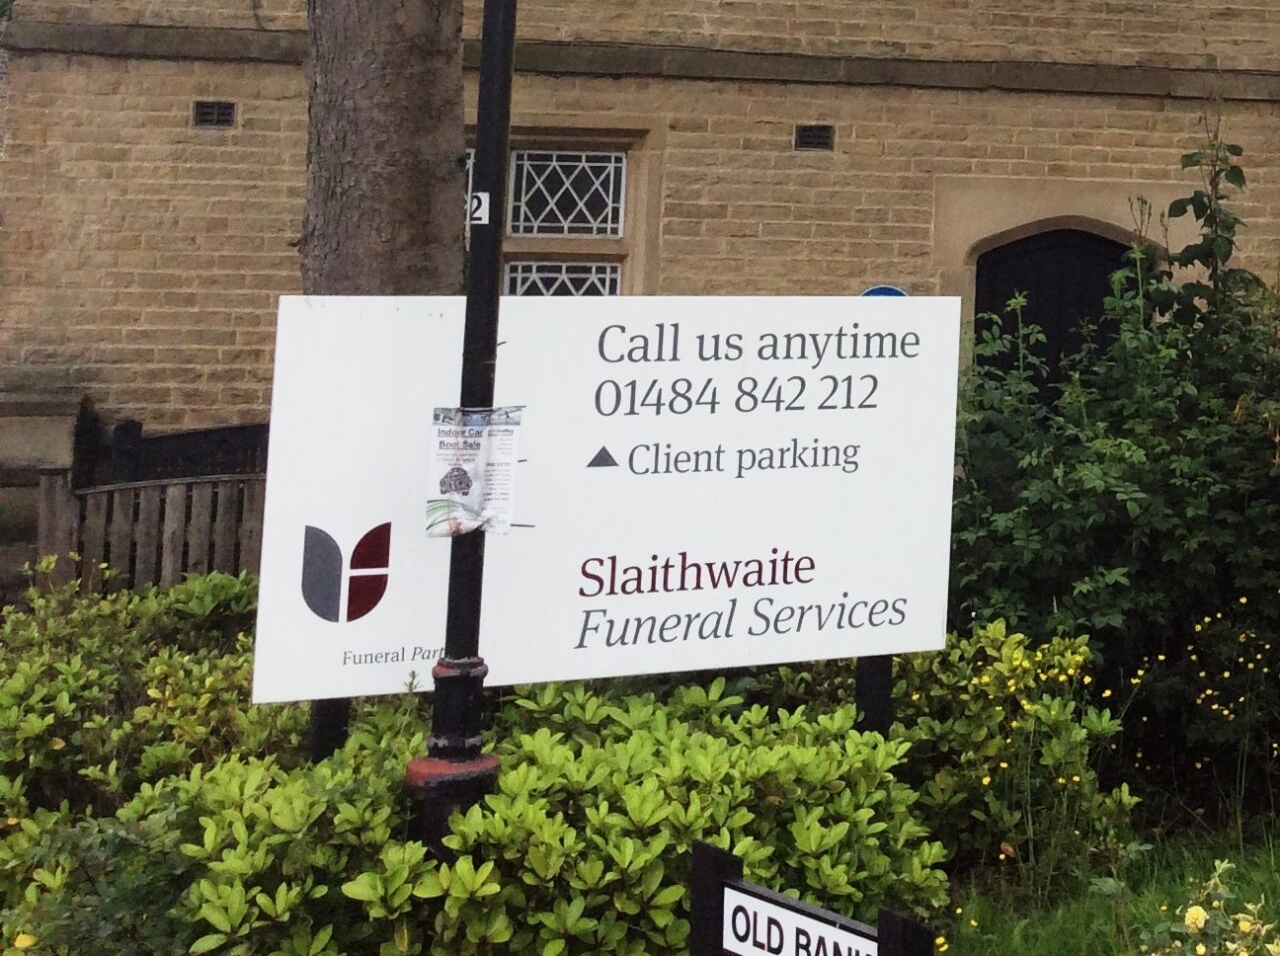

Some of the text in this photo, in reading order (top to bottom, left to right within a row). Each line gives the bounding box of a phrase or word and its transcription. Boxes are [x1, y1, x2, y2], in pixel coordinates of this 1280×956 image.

[598, 322, 920, 370] Call us anytime
[594, 374, 879, 417] 01484 842 212
[628, 437, 861, 479] Client parking
[578, 547, 816, 598] Slaithwaite
[573, 591, 908, 650] Funeral Services
[342, 647, 446, 666] Funeral Part
[732, 905, 873, 956] OLD BA
